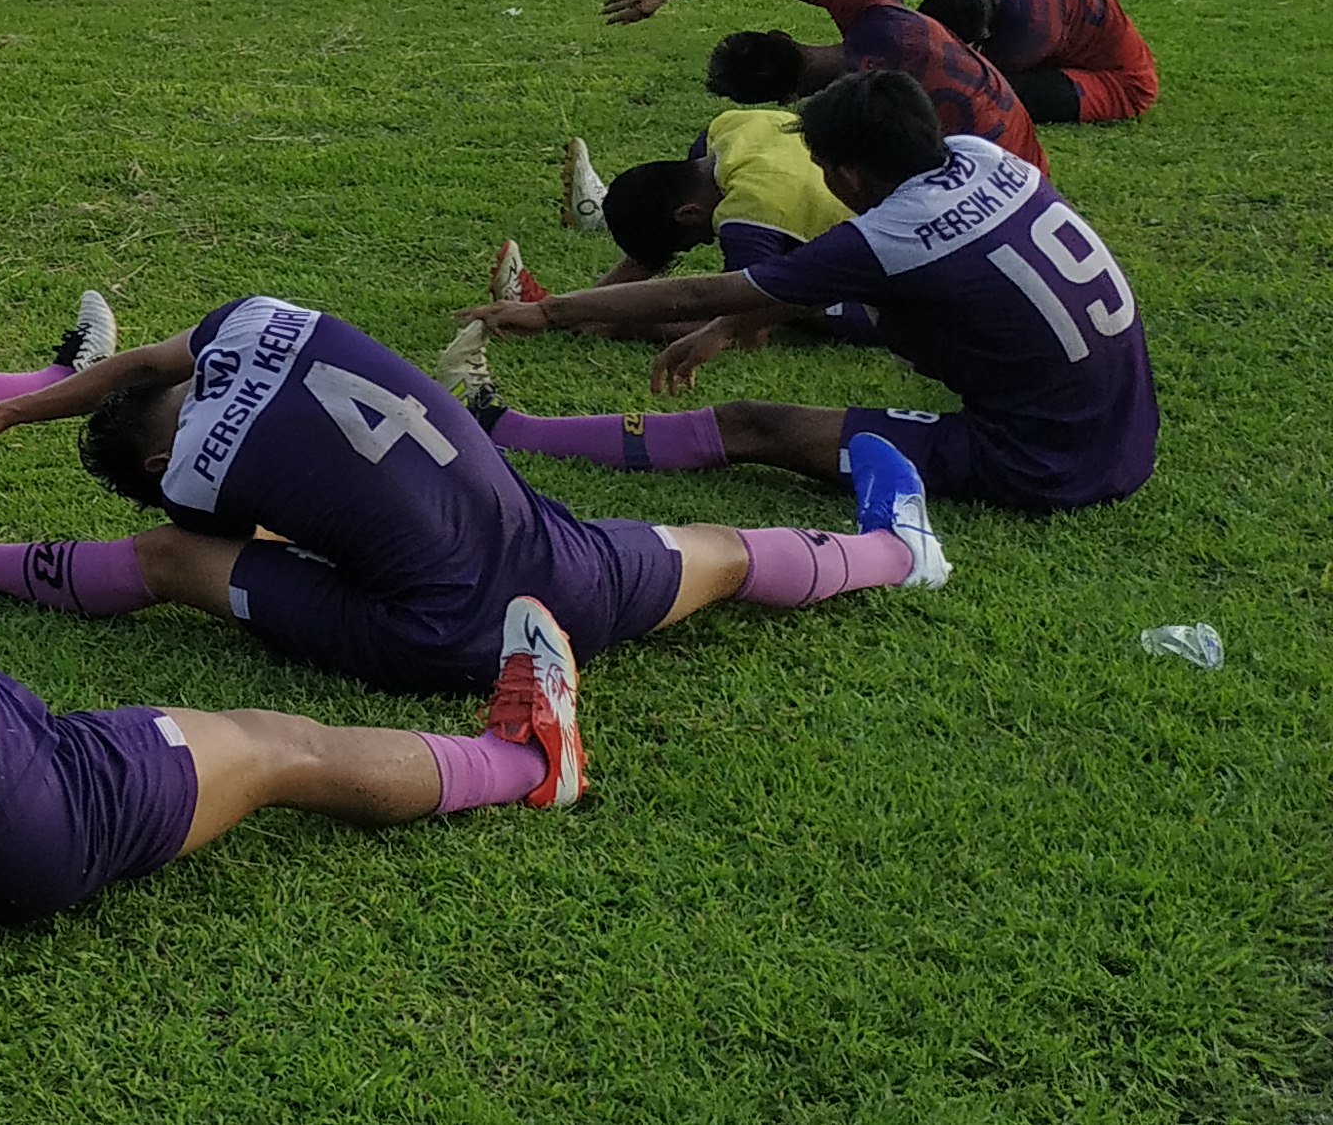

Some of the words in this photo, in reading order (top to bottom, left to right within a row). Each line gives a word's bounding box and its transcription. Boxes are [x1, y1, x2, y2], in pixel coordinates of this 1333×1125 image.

[913, 186, 1005, 251] PERSIK
[986, 154, 1031, 200] KED
[986, 201, 1134, 364] 19
[192, 377, 272, 483] PERSIK
[252, 306, 312, 374] KEDIRI
[302, 360, 459, 468] 4
